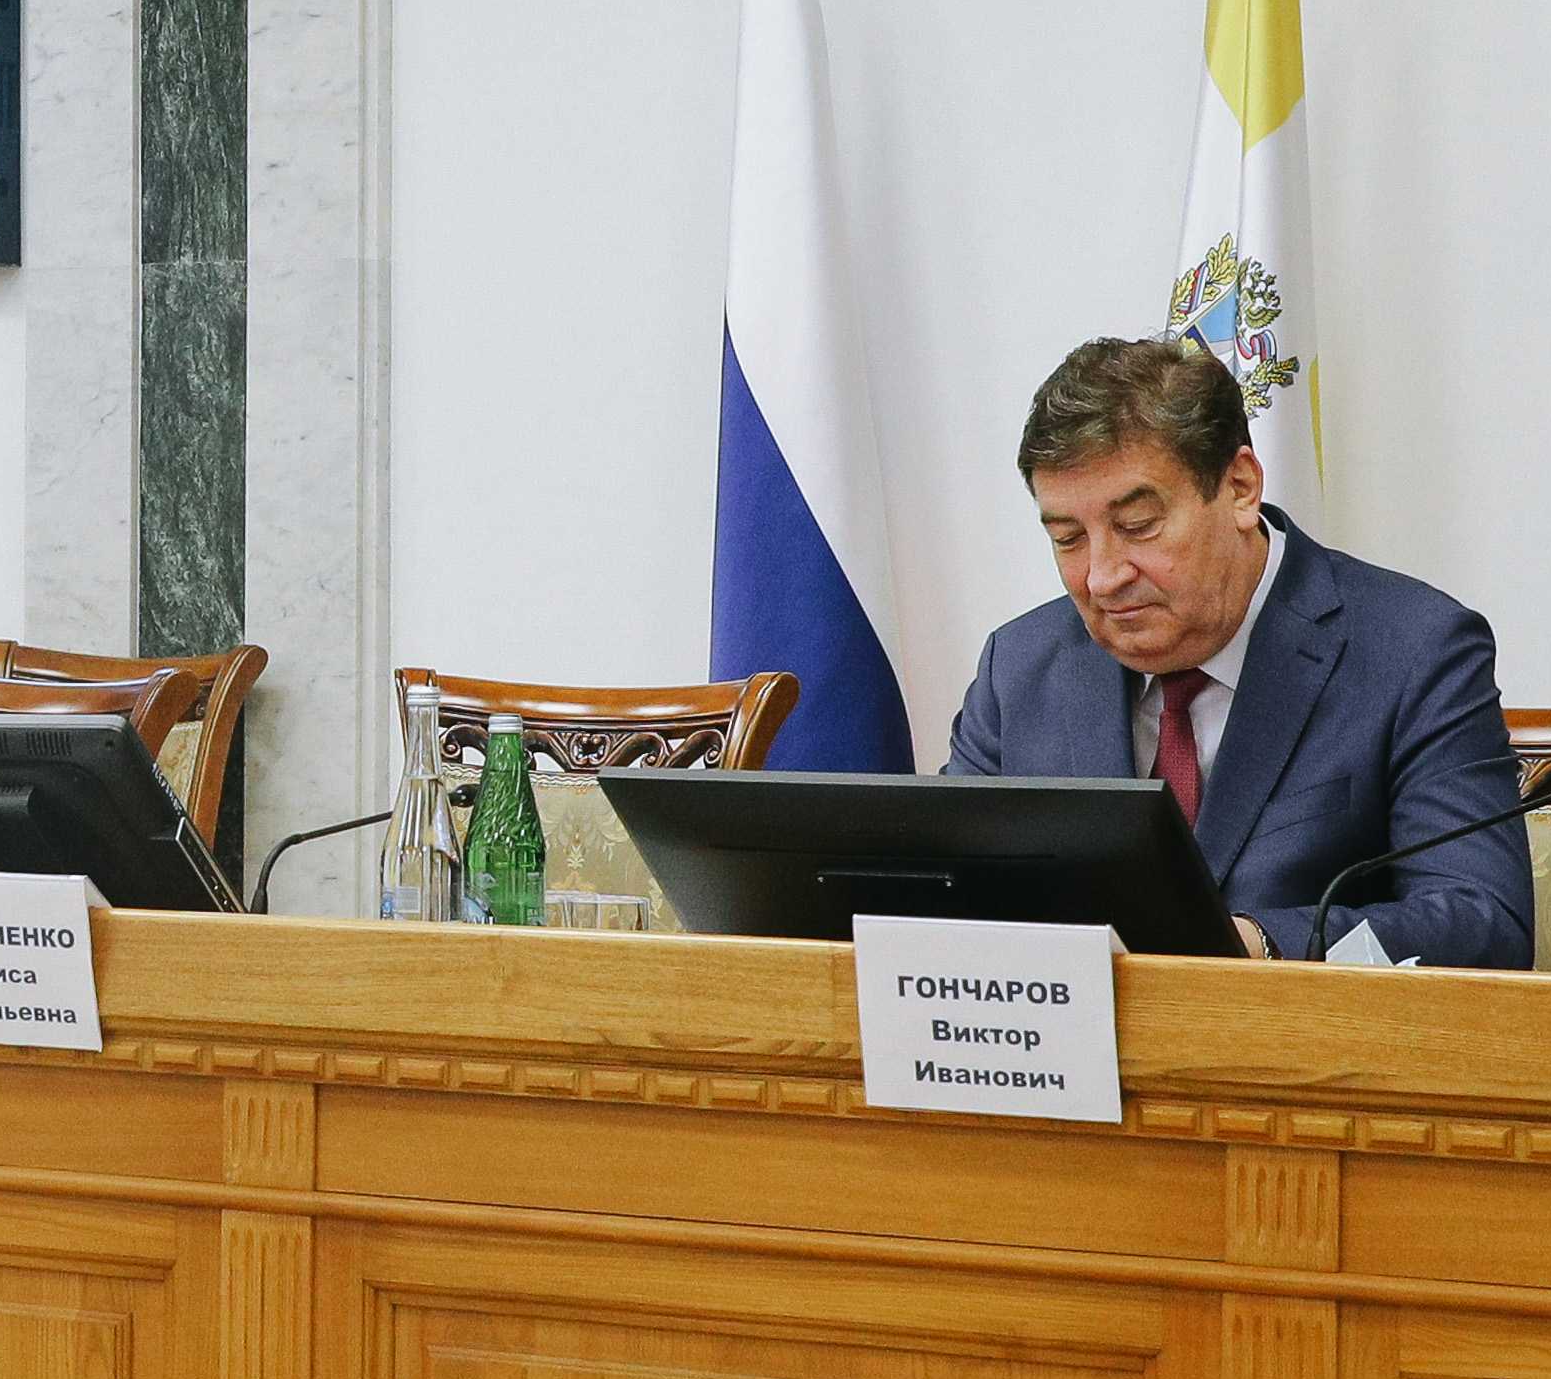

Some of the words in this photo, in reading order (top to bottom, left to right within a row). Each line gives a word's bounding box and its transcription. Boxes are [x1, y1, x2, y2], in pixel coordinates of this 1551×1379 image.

[897, 975, 1071, 1005] ГОНЧАРОВ
[931, 1019, 1041, 1051] Виктор
[914, 1060, 1066, 1090] Иванович
